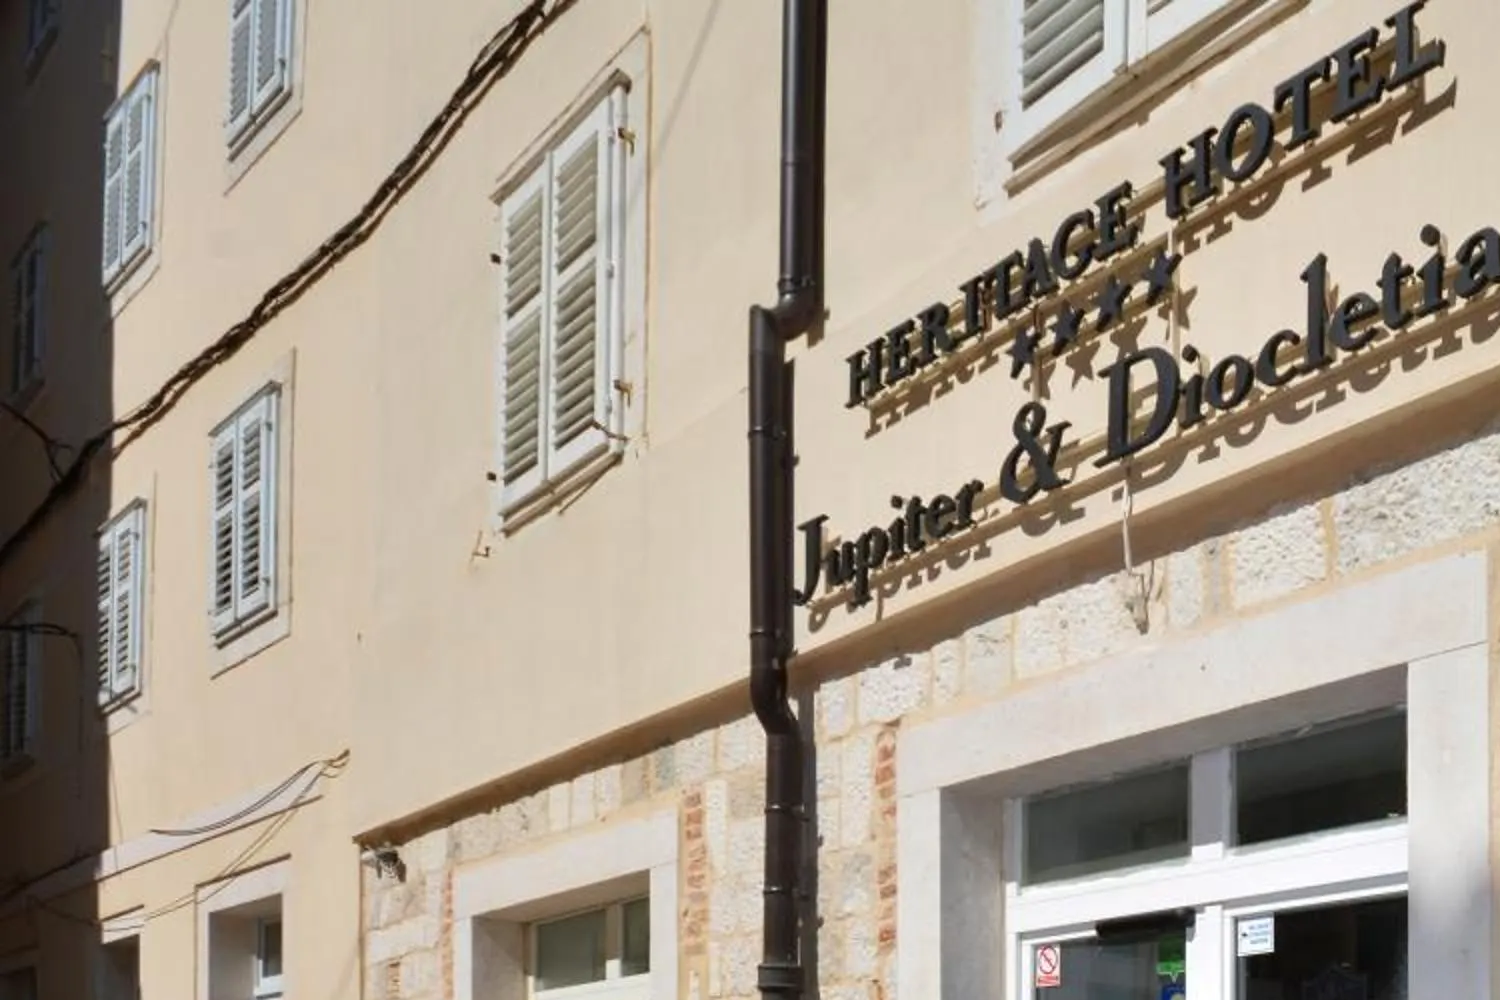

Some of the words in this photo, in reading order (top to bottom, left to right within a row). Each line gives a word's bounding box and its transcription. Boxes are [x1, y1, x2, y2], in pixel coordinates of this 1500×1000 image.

[845, 181, 1138, 408] HERITAGE
[1159, 0, 1446, 218] HOTEL
[793, 478, 984, 606] Jupiter
[1001, 401, 1072, 504] &
